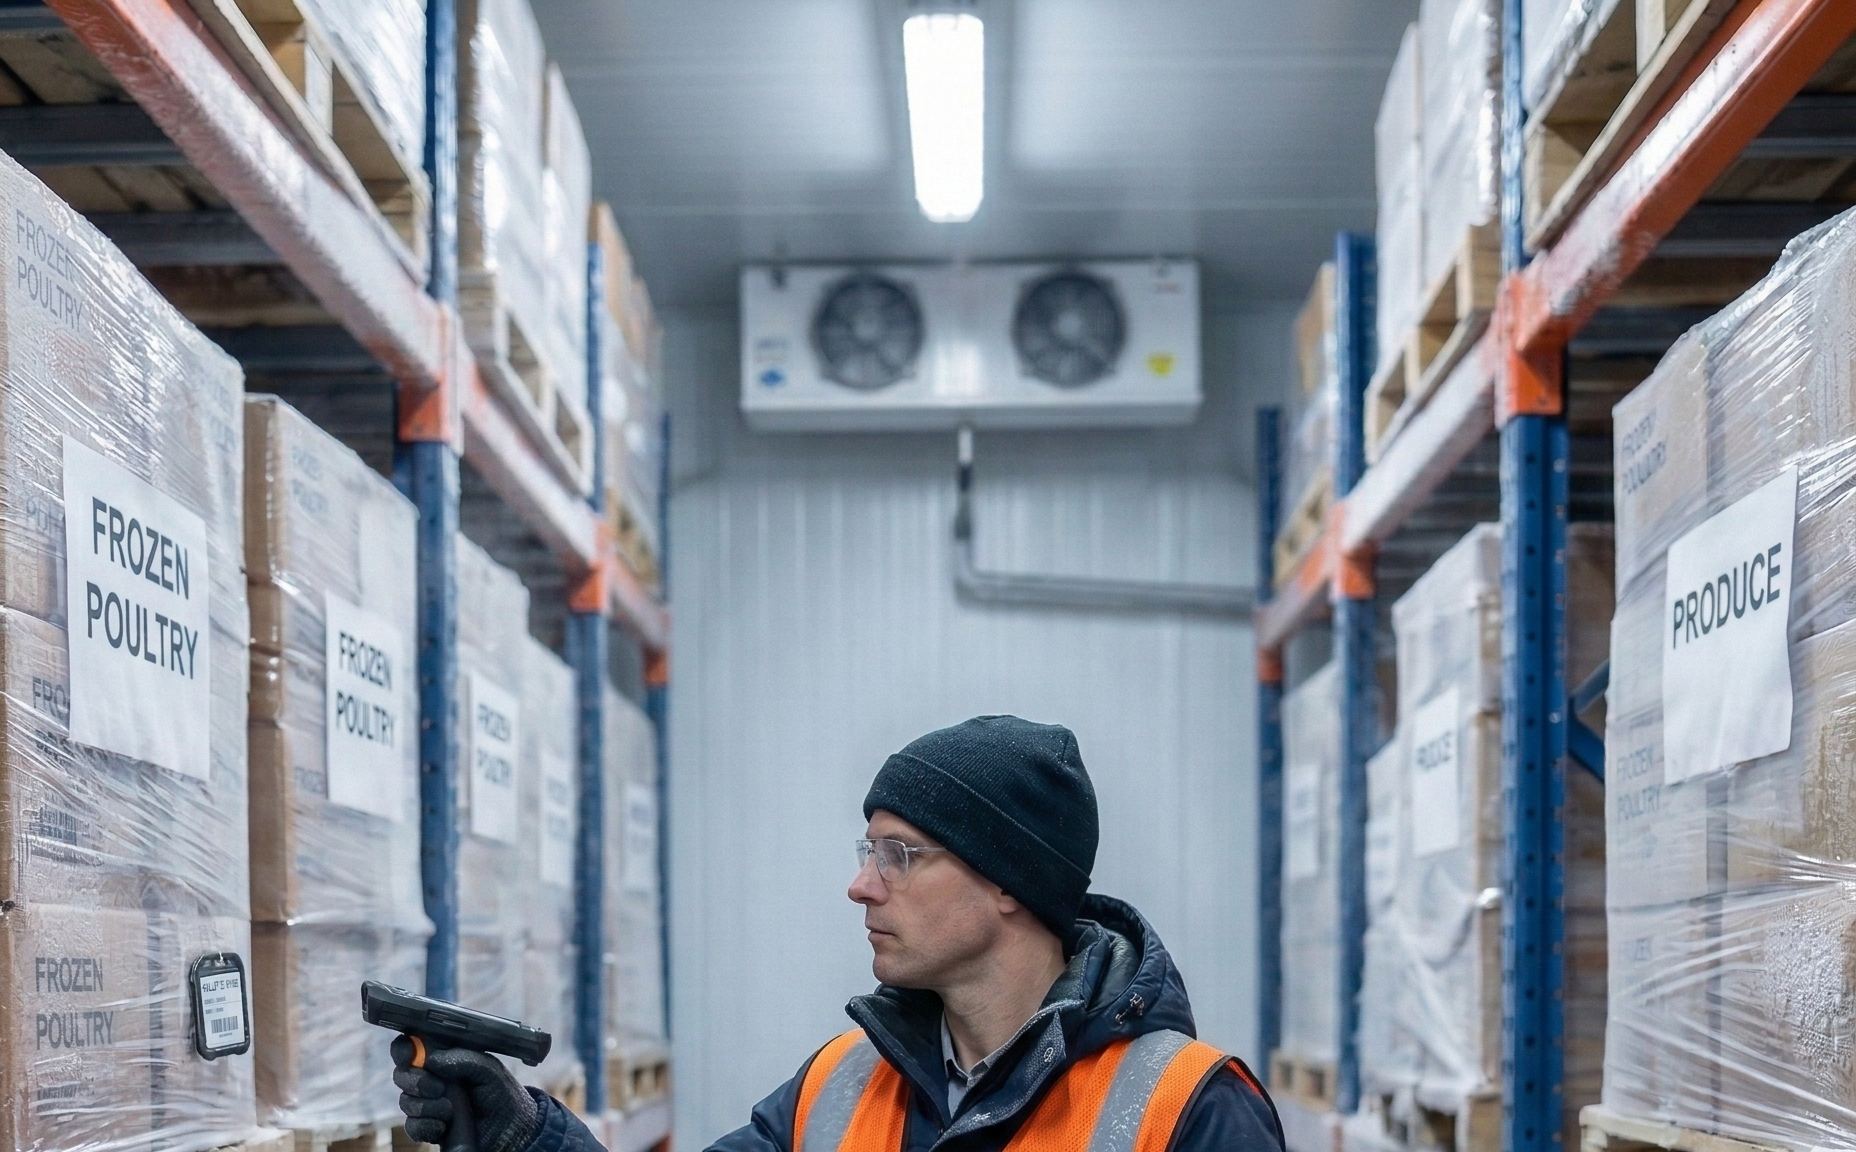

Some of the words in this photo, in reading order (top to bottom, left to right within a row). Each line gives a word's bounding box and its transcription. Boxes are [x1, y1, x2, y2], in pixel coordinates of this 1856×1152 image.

[16, 208, 77, 283] FROZEN
[17, 255, 84, 333] POULTRY
[92, 495, 190, 601] FROZEN
[86, 580, 199, 680] POULTRY
[1672, 542, 1782, 650] PRODUCE
[339, 629, 392, 692] FROZEN
[336, 689, 396, 750] POULTRY
[34, 957, 104, 992] FROZEN
[36, 1010, 115, 1051] POULTRY
